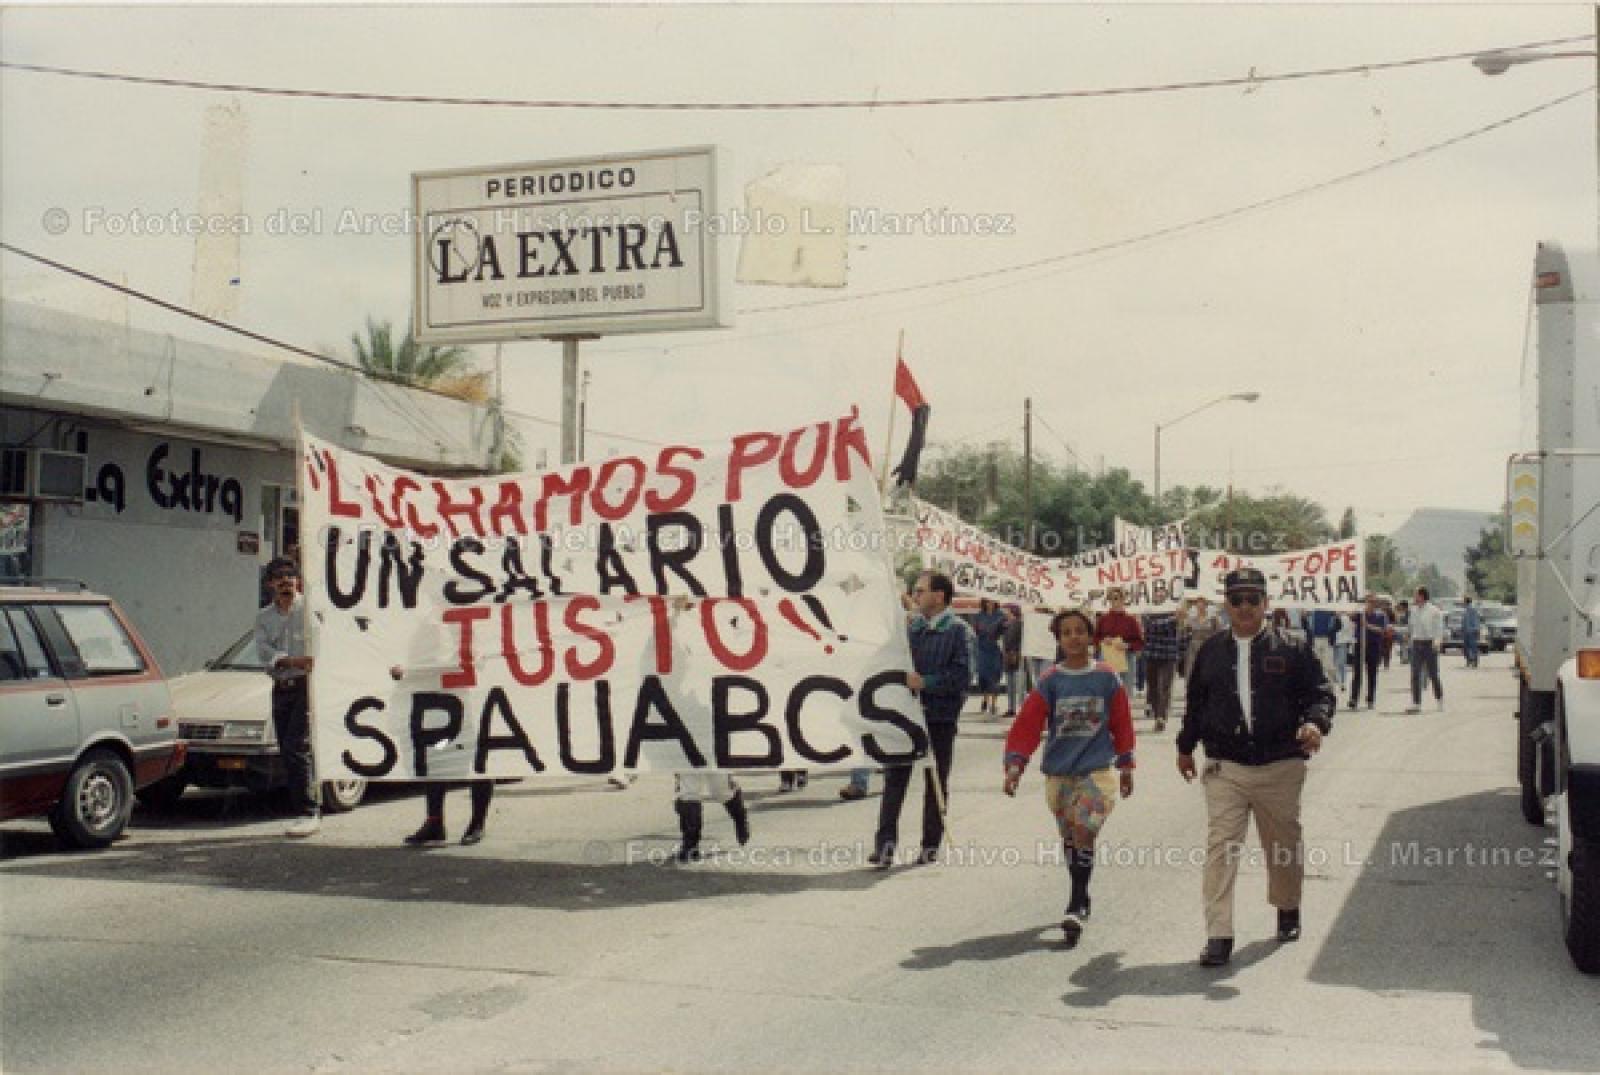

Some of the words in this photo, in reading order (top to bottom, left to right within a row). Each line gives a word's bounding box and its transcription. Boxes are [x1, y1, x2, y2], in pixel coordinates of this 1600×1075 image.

[487, 167, 636, 198] PERIODICO
[437, 234, 505, 284] LA
[517, 221, 684, 278] EXTRA
[146, 443, 243, 523] Extra
[725, 405, 872, 500] POR
[326, 526, 426, 609] UN
[442, 492, 827, 604] SALARIO
[1279, 543, 1357, 575] TOPE
[341, 670, 931, 777] SPAUABCS
